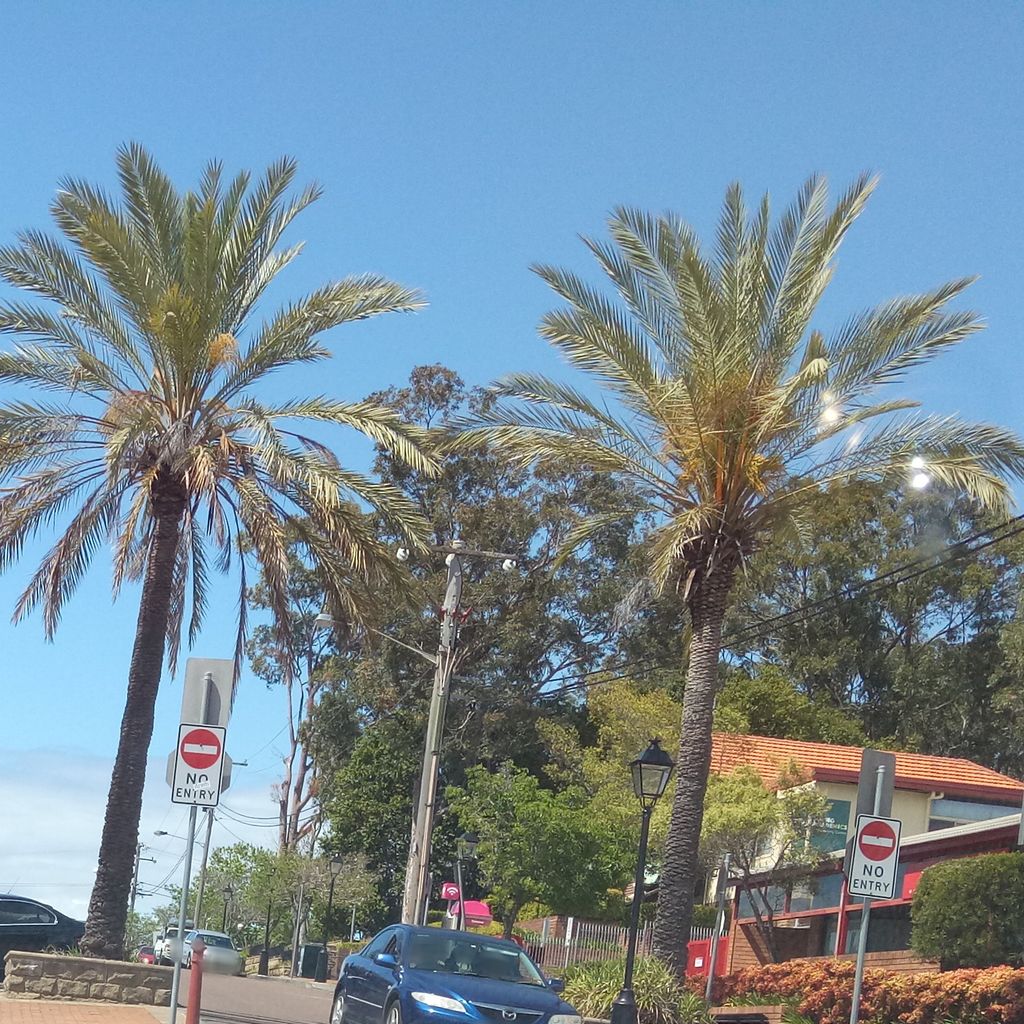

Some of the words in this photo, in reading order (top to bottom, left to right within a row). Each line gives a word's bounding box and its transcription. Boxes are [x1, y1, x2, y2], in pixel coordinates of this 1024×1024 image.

[186, 772, 209, 785] NO
[176, 787, 215, 800] ENTRY
[863, 864, 884, 878] NO
[853, 879, 890, 892] ENTRY
